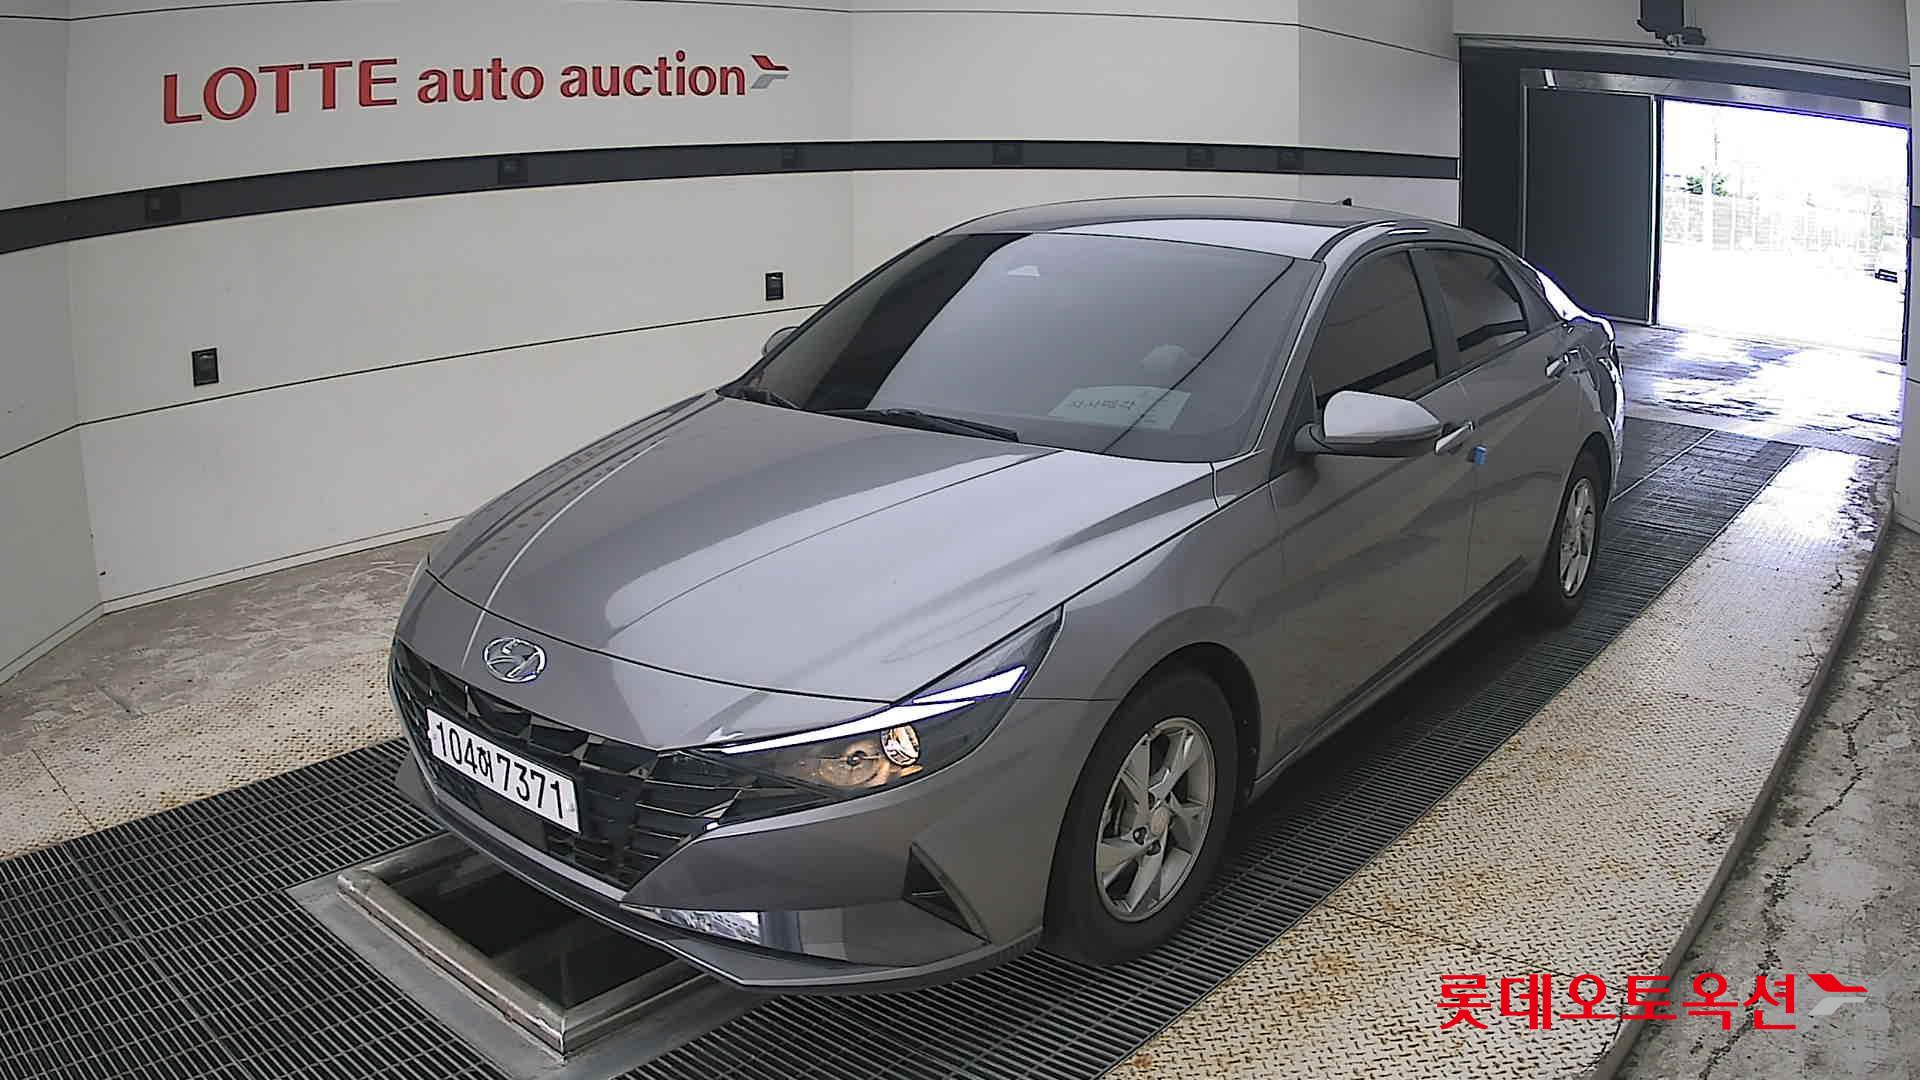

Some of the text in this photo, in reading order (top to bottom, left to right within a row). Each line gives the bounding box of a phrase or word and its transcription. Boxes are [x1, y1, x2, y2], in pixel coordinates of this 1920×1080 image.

[163, 50, 746, 124] LOTTE auto auction
